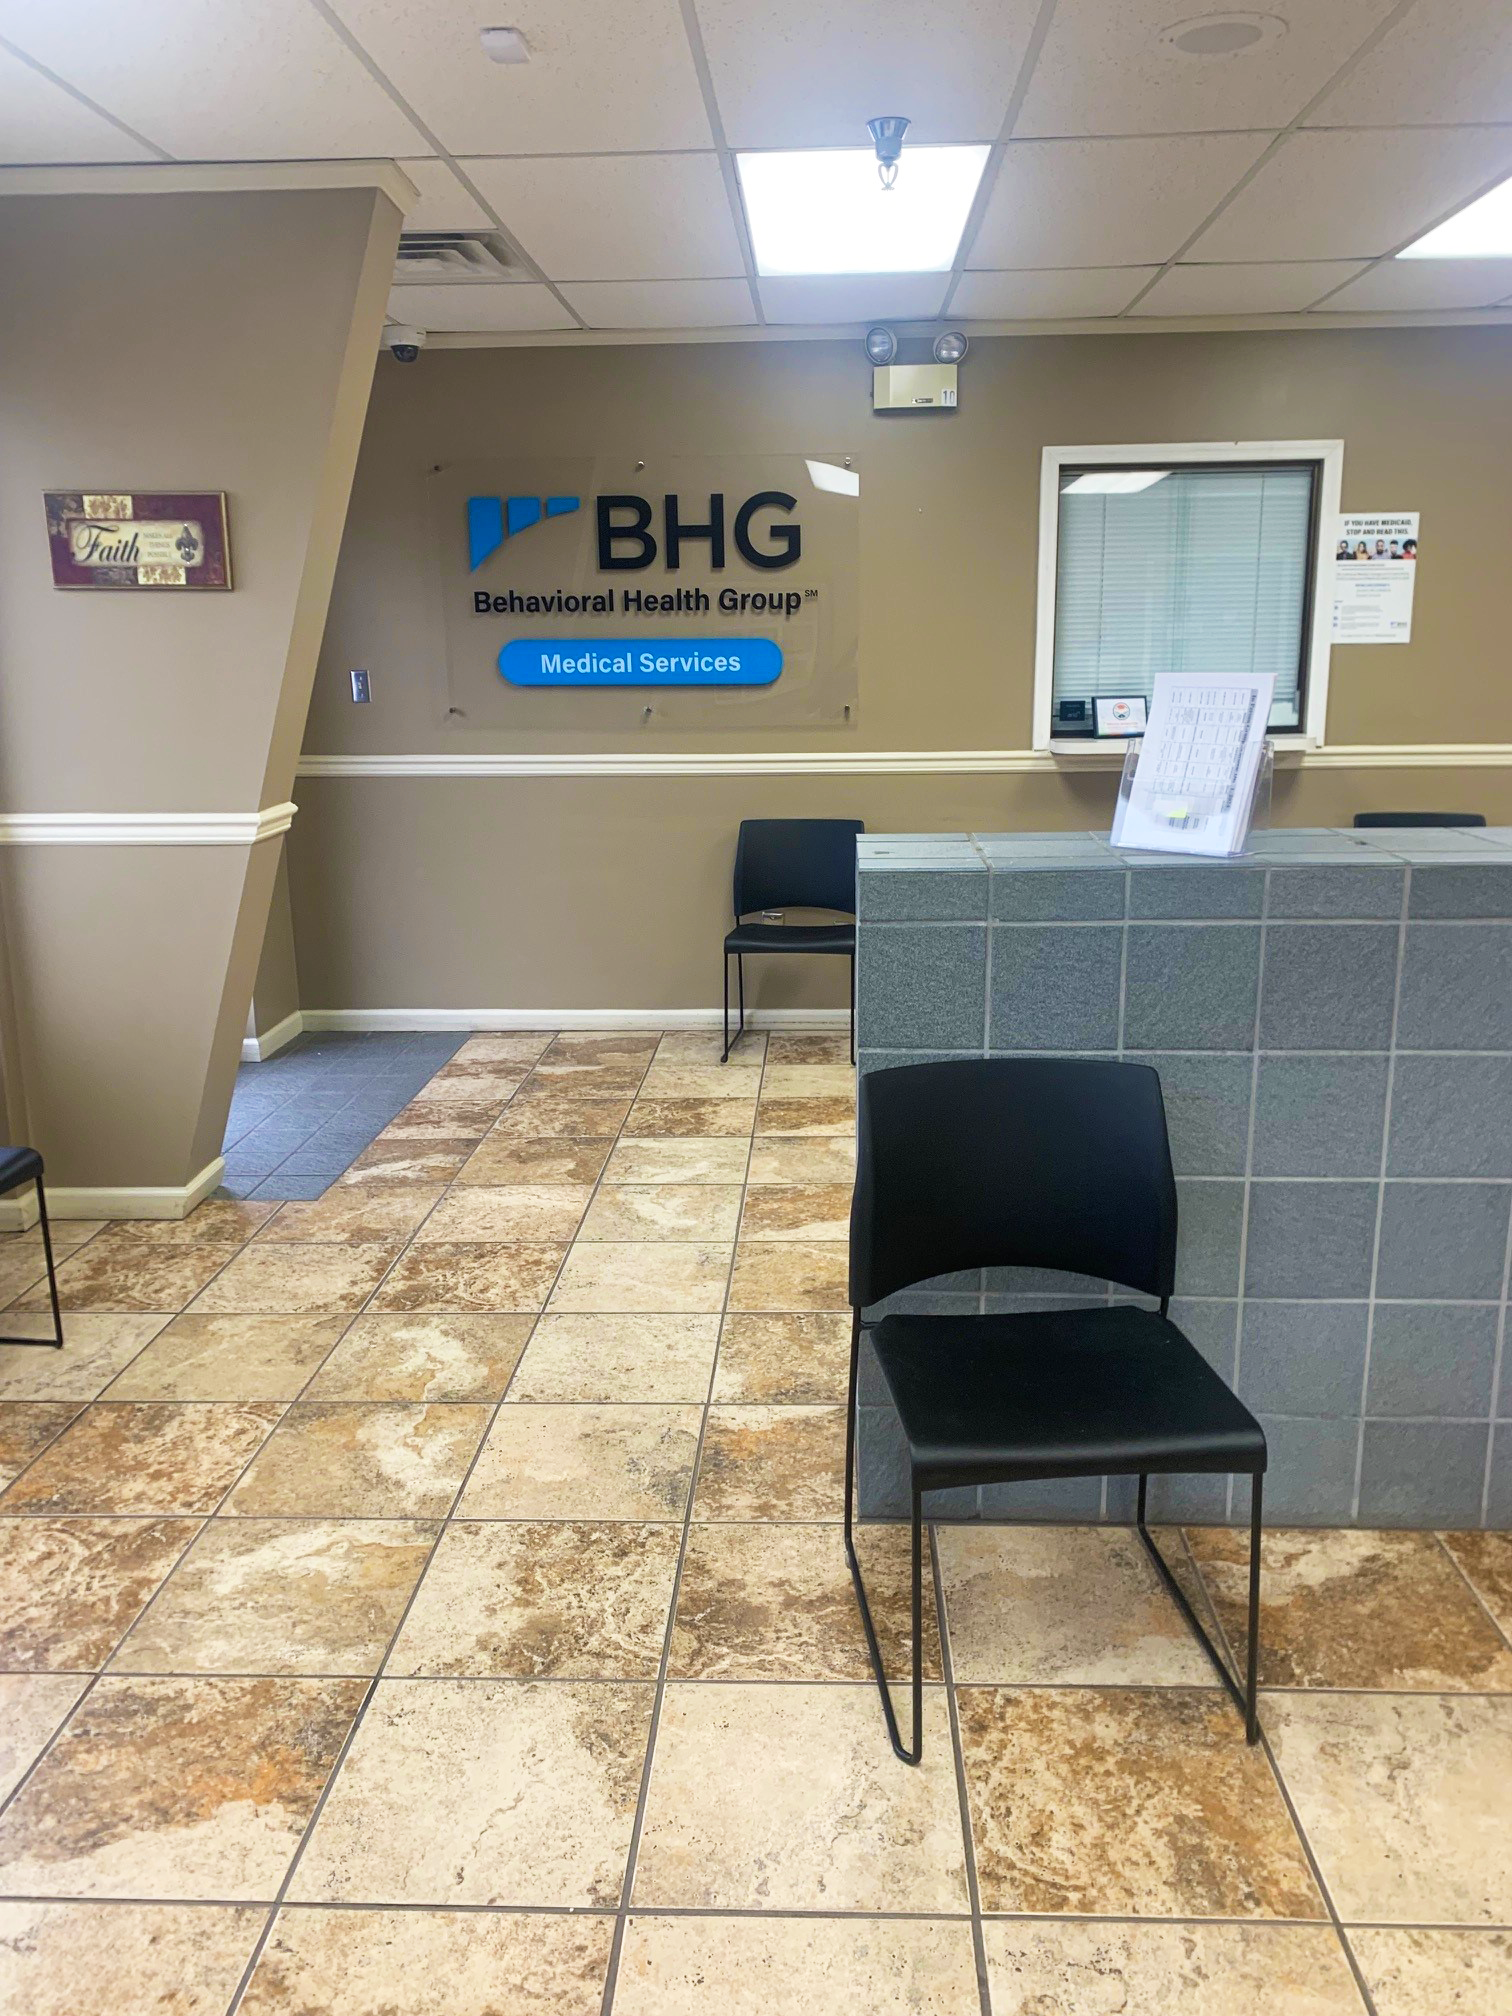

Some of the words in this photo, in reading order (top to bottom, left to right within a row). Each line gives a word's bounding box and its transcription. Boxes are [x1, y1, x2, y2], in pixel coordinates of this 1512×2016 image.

[943, 391, 955, 404] 10
[75, 524, 140, 563] Faith
[595, 490, 802, 570] BHG
[473, 589, 615, 614] Behavioral
[623, 587, 711, 613] Health
[718, 587, 802, 616] Group
[540, 653, 633, 674] Medical
[640, 650, 741, 673] Services
